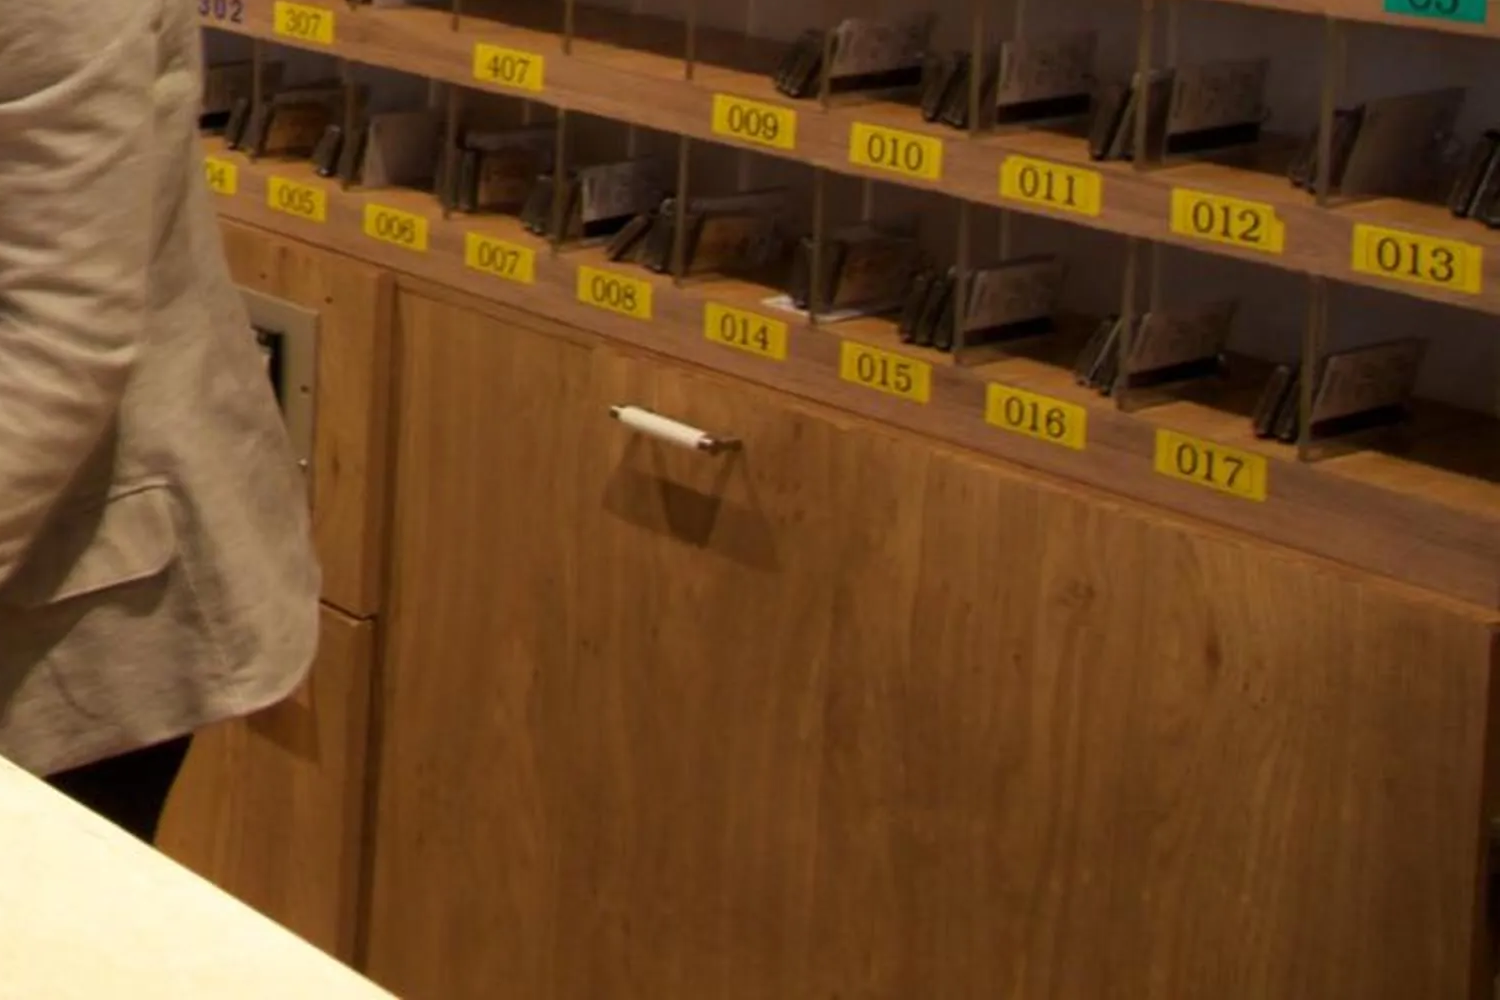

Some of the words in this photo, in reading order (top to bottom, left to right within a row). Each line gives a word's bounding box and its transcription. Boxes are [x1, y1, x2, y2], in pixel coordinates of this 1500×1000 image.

[285, 7, 322, 37] 307
[487, 55, 531, 83] 407
[727, 104, 780, 140] 009
[867, 132, 924, 171] 010
[277, 184, 316, 213] 005
[1018, 166, 1075, 206] 011
[375, 211, 415, 242] 006
[1192, 201, 1261, 243] 012
[478, 241, 521, 274] 007
[1376, 237, 1454, 282] 013
[591, 275, 637, 311] 008
[720, 313, 769, 349] 014
[857, 353, 913, 391] 015
[1004, 396, 1066, 437] 016
[1176, 443, 1244, 486] 017
